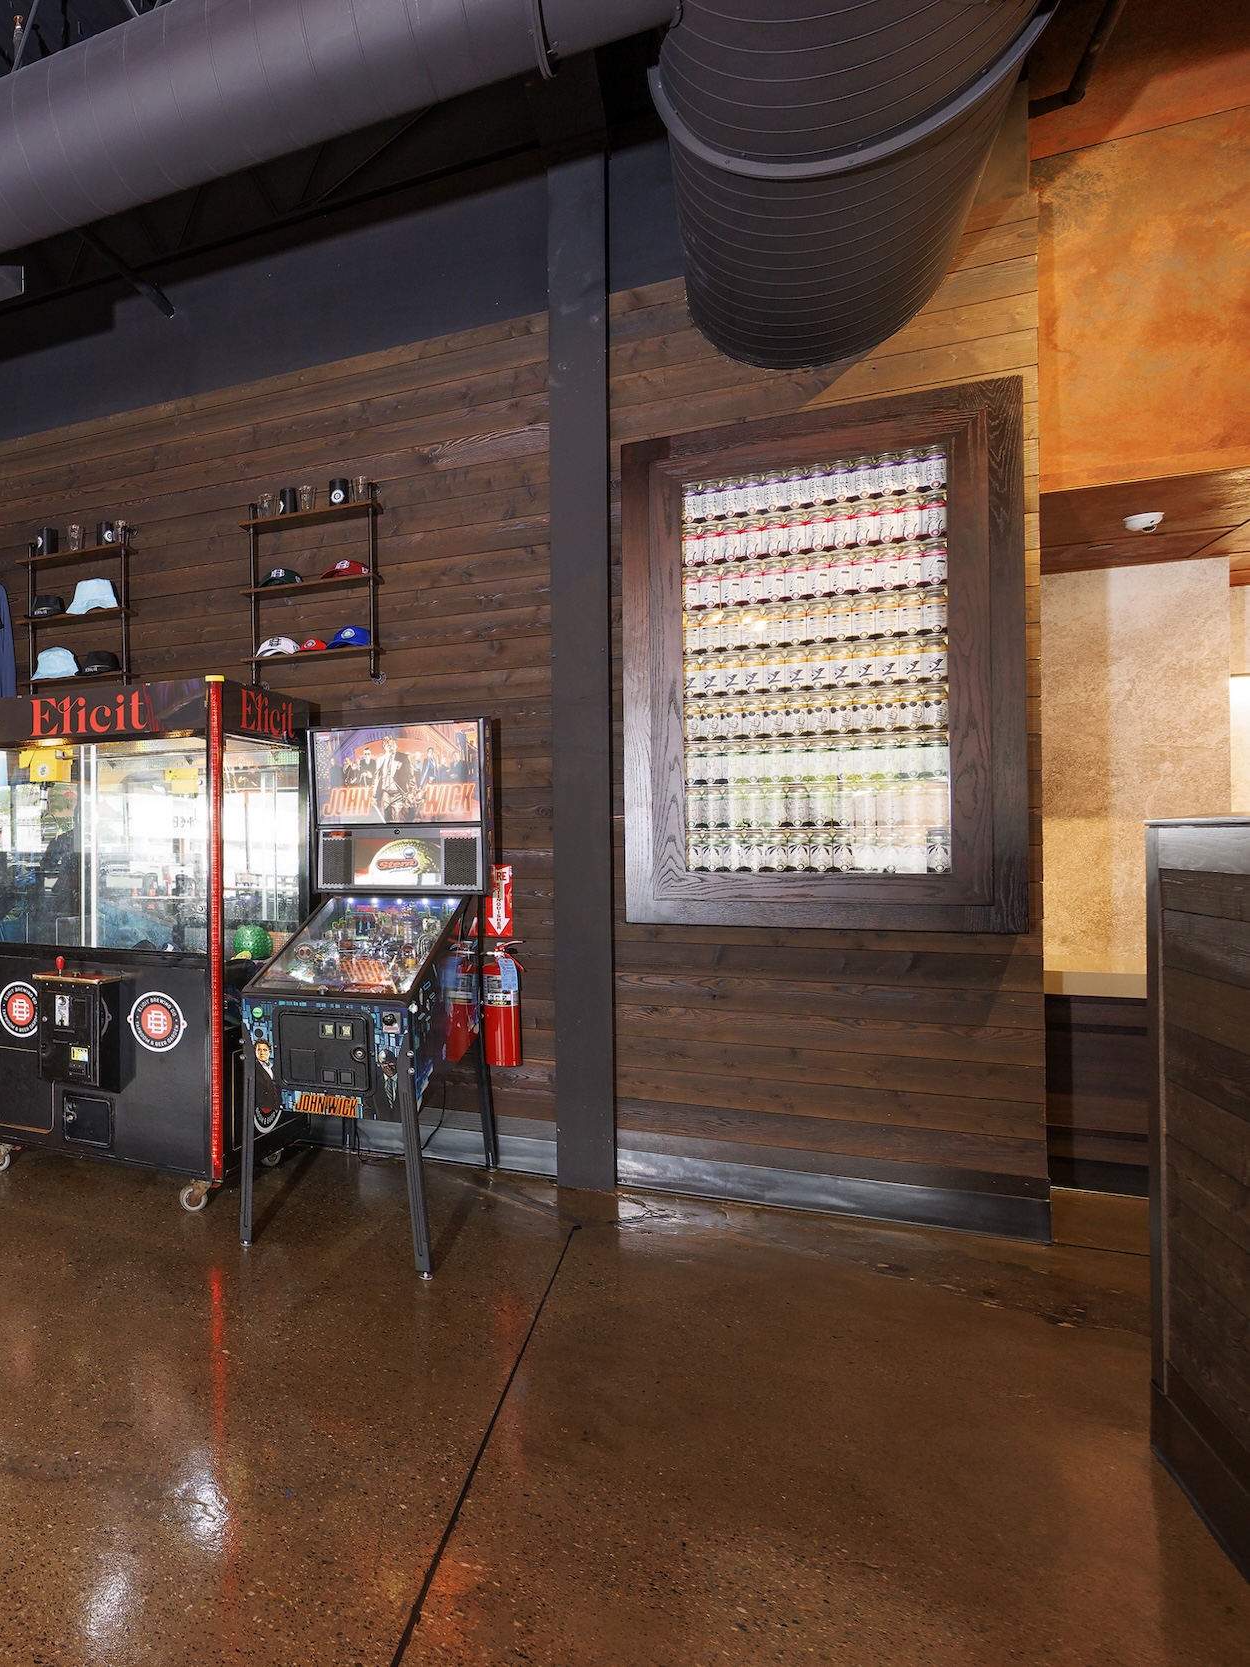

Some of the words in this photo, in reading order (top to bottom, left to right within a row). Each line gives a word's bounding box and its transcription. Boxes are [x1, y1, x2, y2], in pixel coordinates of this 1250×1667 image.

[30, 690, 148, 737] Elicit
[241, 689, 295, 739] Elicit
[322, 786, 373, 817] JOHN
[423, 782, 476, 815] WICK
[379, 861, 416, 870] Stern
[14, 986, 33, 998] BREWING
[150, 997, 171, 1009] BREWING
[295, 1094, 325, 1115] JOHN
[327, 1096, 358, 1118] WICK
